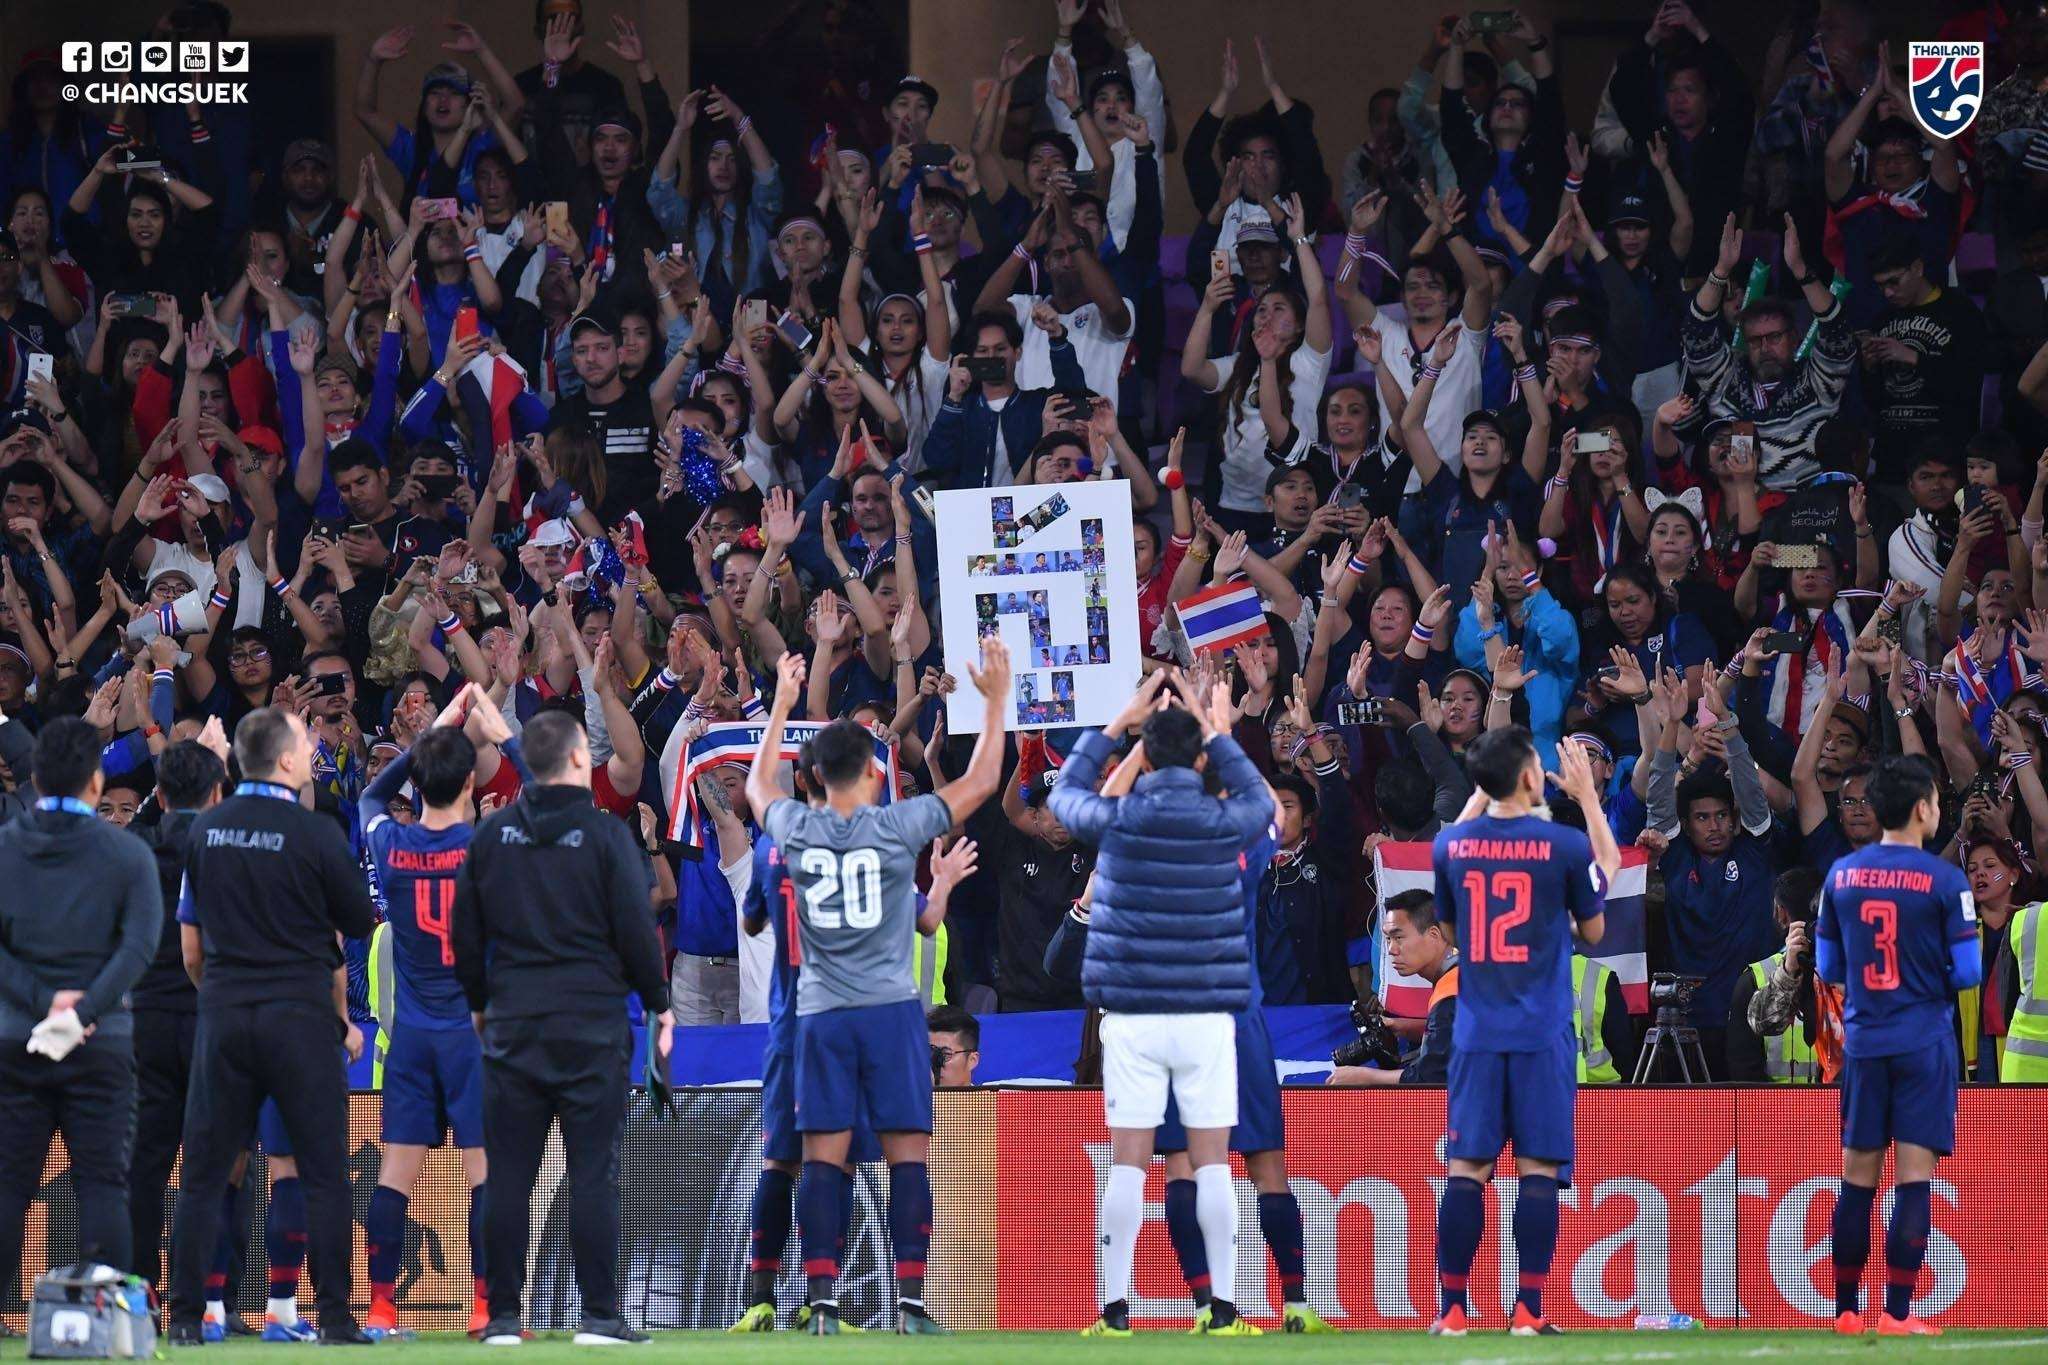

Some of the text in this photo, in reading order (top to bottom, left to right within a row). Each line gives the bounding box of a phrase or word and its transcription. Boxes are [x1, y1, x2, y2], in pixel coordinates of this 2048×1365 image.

[1791, 517, 1837, 527] SECURITY
[747, 729, 818, 743] THLAN
[206, 827, 285, 852] THAILAND
[1447, 838, 1552, 861] P.CHANANAN
[414, 877, 457, 967] 4
[779, 877, 802, 967] 1
[801, 847, 883, 929] 20
[1463, 870, 1533, 963] 12
[1834, 867, 1933, 895] B.THEERATHON
[1860, 899, 1901, 992] 3
[1083, 1134, 1969, 1319] Emates
